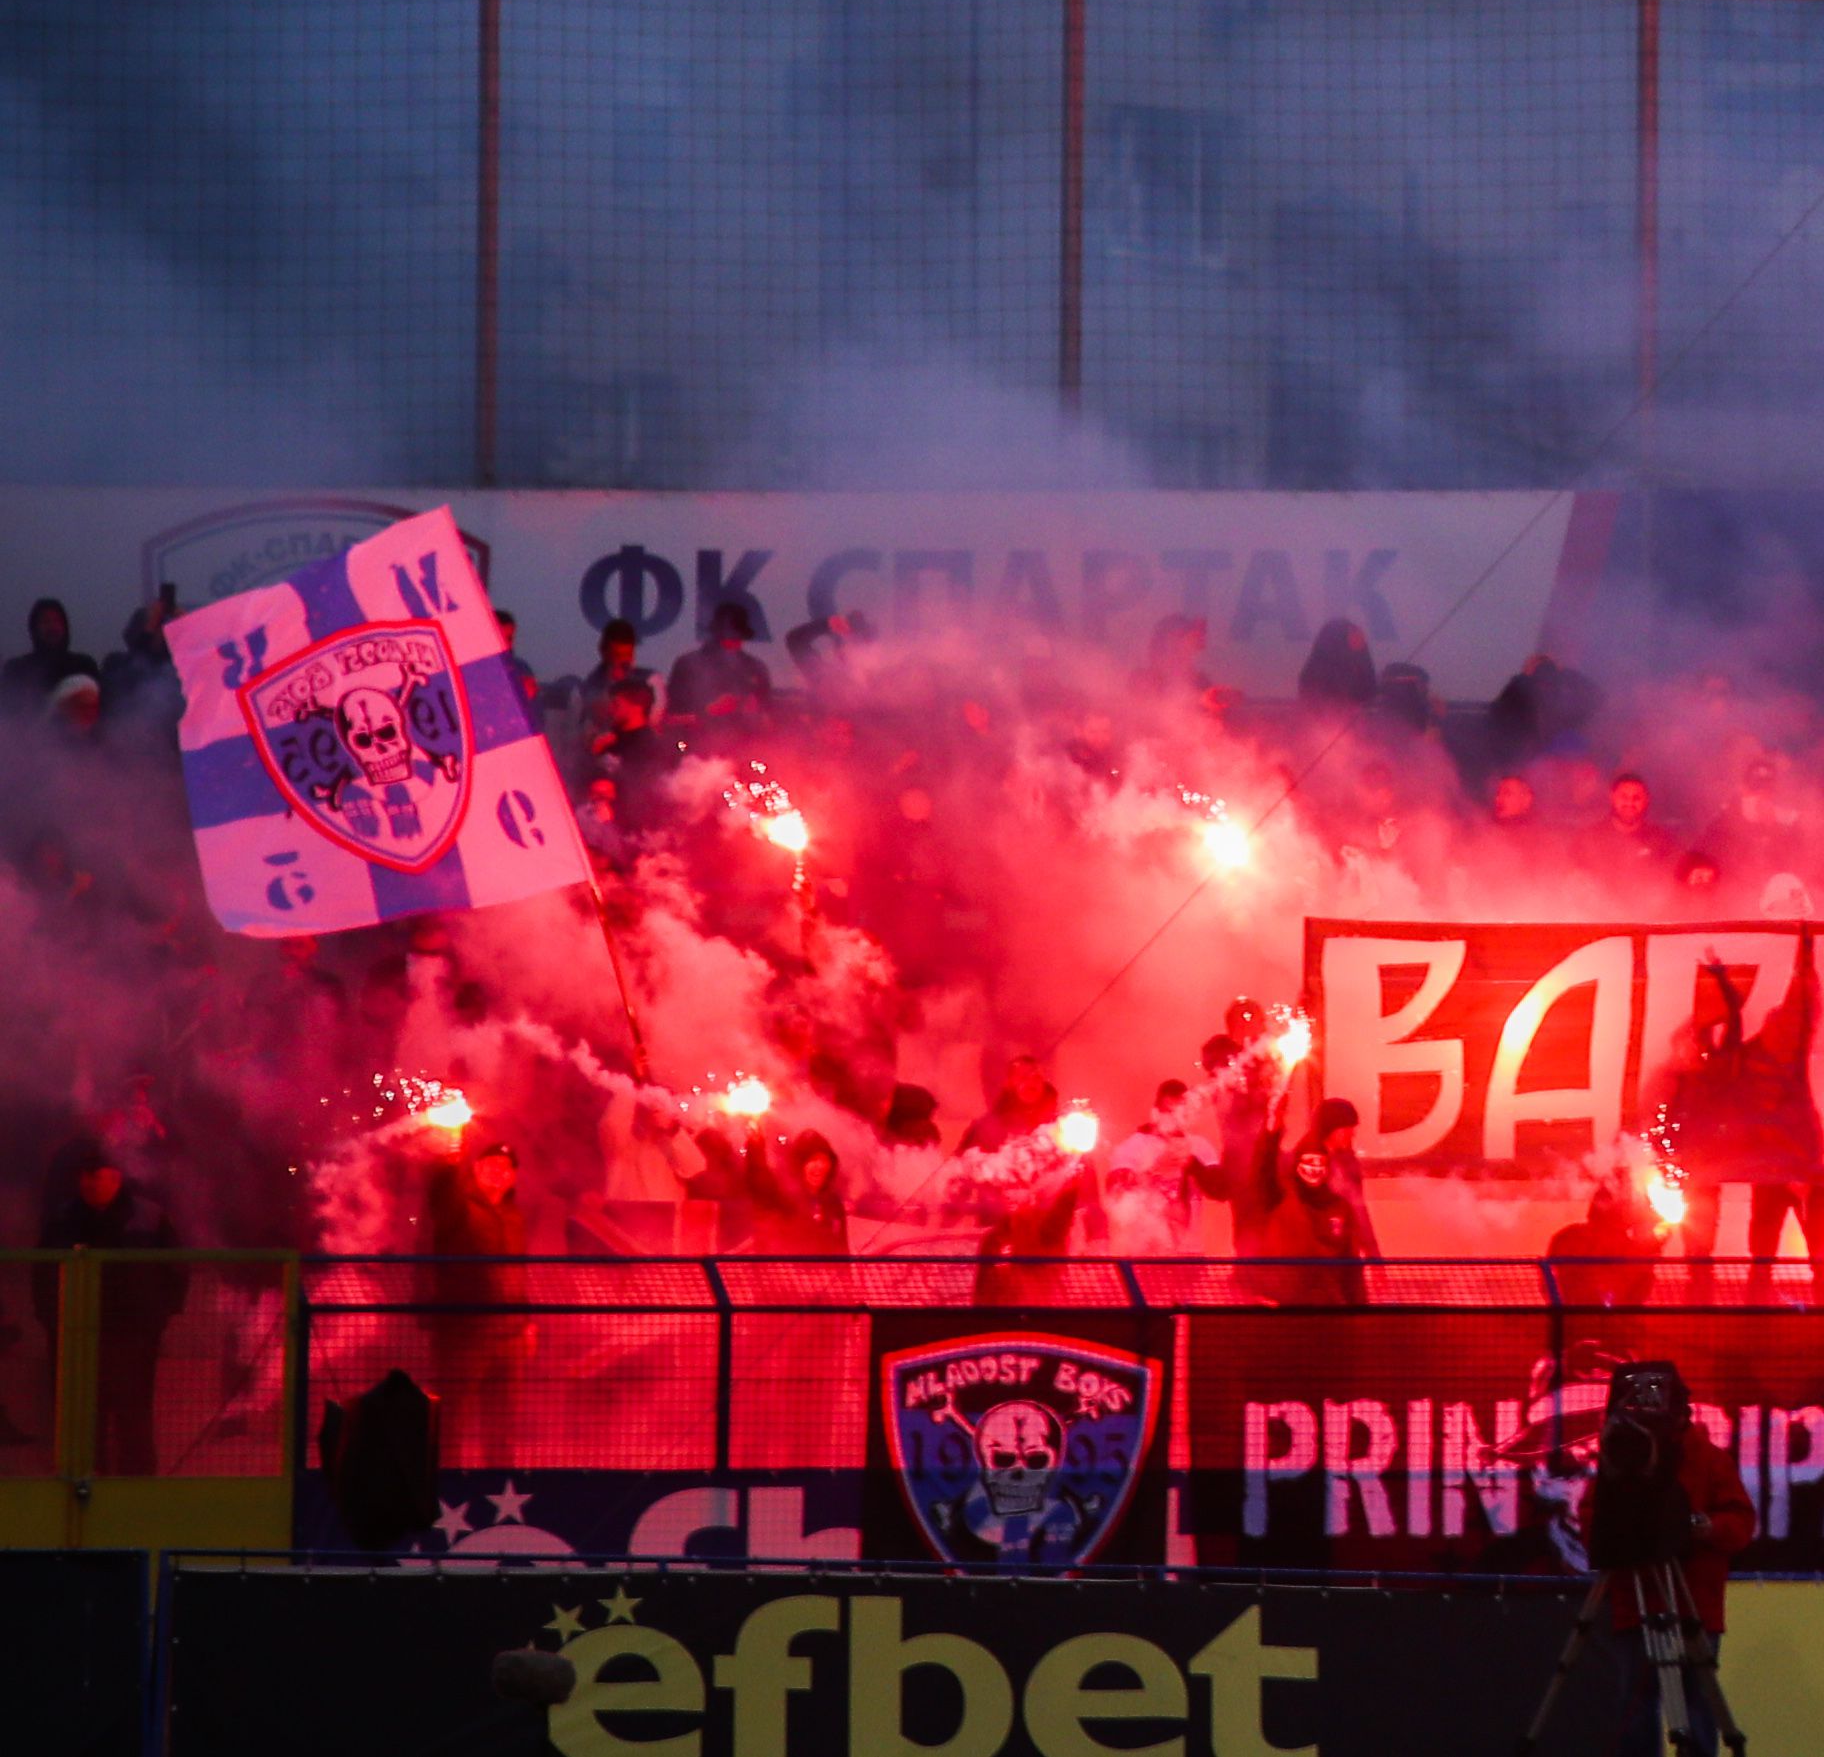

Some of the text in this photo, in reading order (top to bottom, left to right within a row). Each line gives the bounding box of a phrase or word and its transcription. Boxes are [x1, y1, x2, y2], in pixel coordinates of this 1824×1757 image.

[580, 544, 1398, 642] ФК СПАРТАК
[548, 1595, 1319, 1757] efbet
